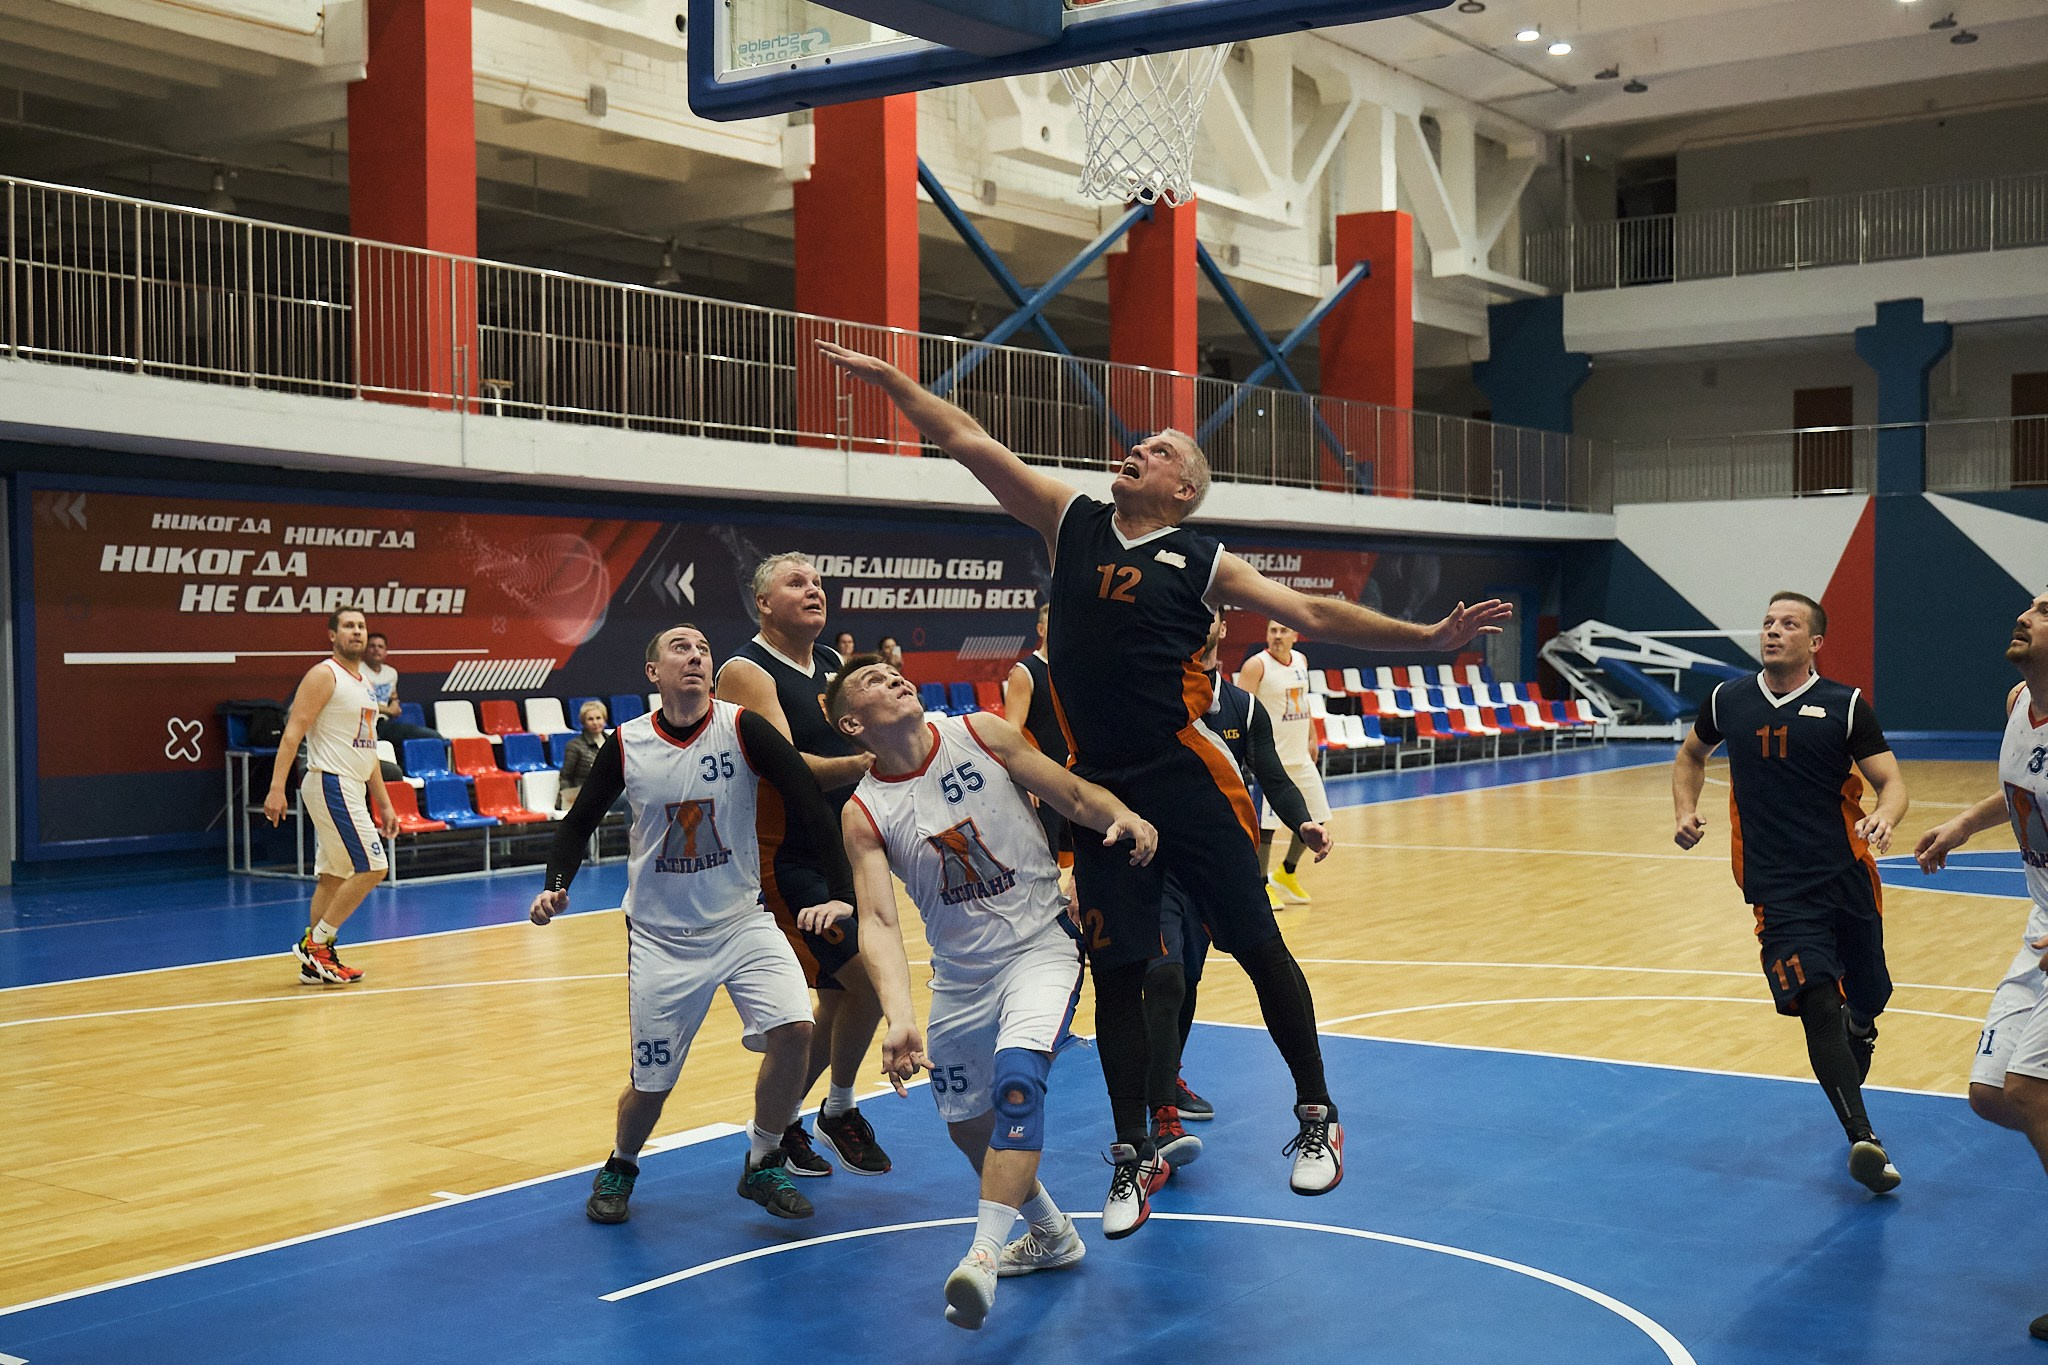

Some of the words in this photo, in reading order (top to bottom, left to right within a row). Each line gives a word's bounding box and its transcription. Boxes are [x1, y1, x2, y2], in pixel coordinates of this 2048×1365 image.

[151, 513, 271, 534] НИКОГДА
[284, 526, 415, 548] НИКОГДА
[100, 545, 308, 576] НИКОГДА
[945, 559, 1003, 580] СЕБЯ
[1234, 552, 1302, 572] ОБЕДЫ
[180, 584, 239, 612] НЕ
[244, 582, 466, 614] СДАВАЙСЯ!
[840, 587, 983, 609] ПОБЕДИШЬ
[984, 589, 1037, 609] ВСЕХ
[1097, 563, 1142, 603] 12
[1755, 724, 1788, 759] 11
[700, 751, 735, 783] 35
[940, 761, 987, 805] 55
[371, 842, 382, 855] 9
[655, 849, 732, 874] АТЛАНТ
[940, 869, 1016, 906] АТЛАНТ
[1771, 953, 1806, 990] 11
[637, 1039, 671, 1067] 35
[931, 1065, 970, 1094] 55
